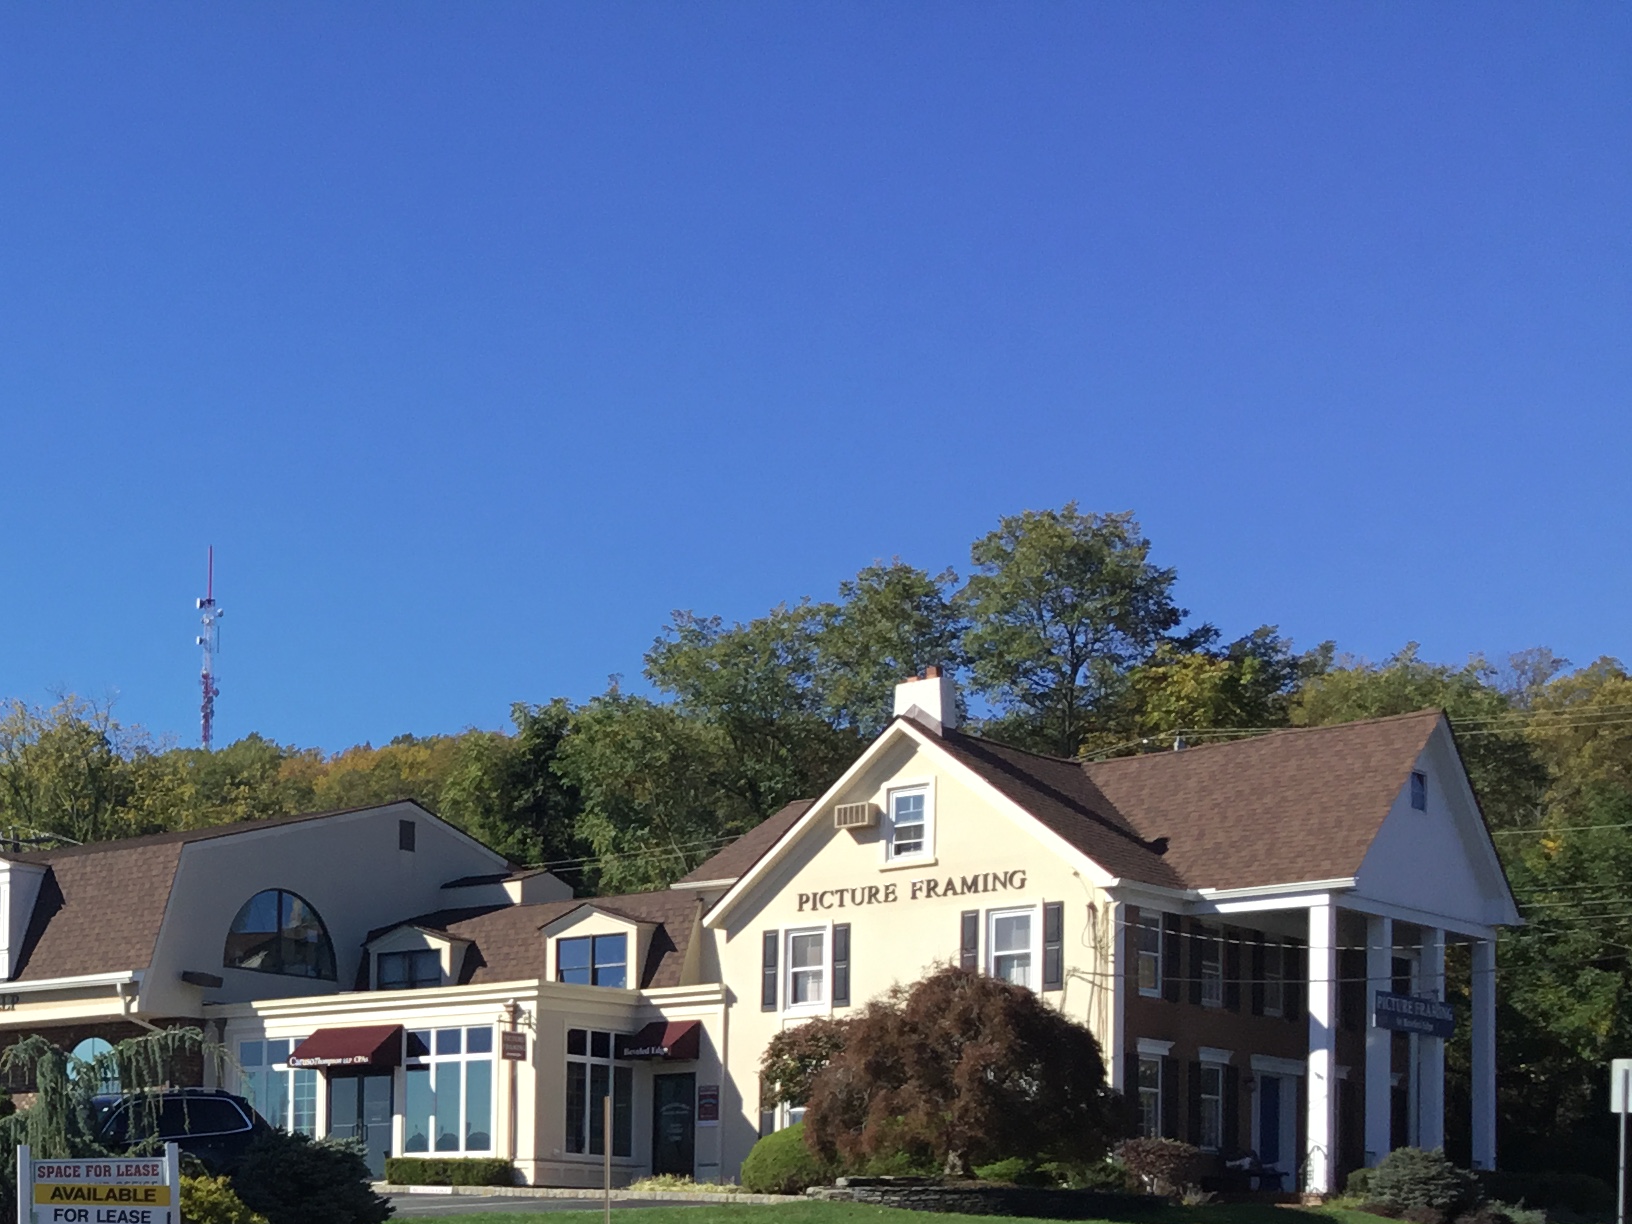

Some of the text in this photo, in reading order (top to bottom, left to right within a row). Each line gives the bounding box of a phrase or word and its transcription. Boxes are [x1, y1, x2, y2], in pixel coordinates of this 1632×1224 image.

[797, 869, 1027, 912] PICTURE FRAMING
[1377, 995, 1454, 1021] PICTURE FRAMING
[37, 1164, 160, 1179] SPACE FOR LEASE
[50, 1186, 157, 1203] AVAILABLE
[54, 1208, 152, 1224] FOR LEASE
